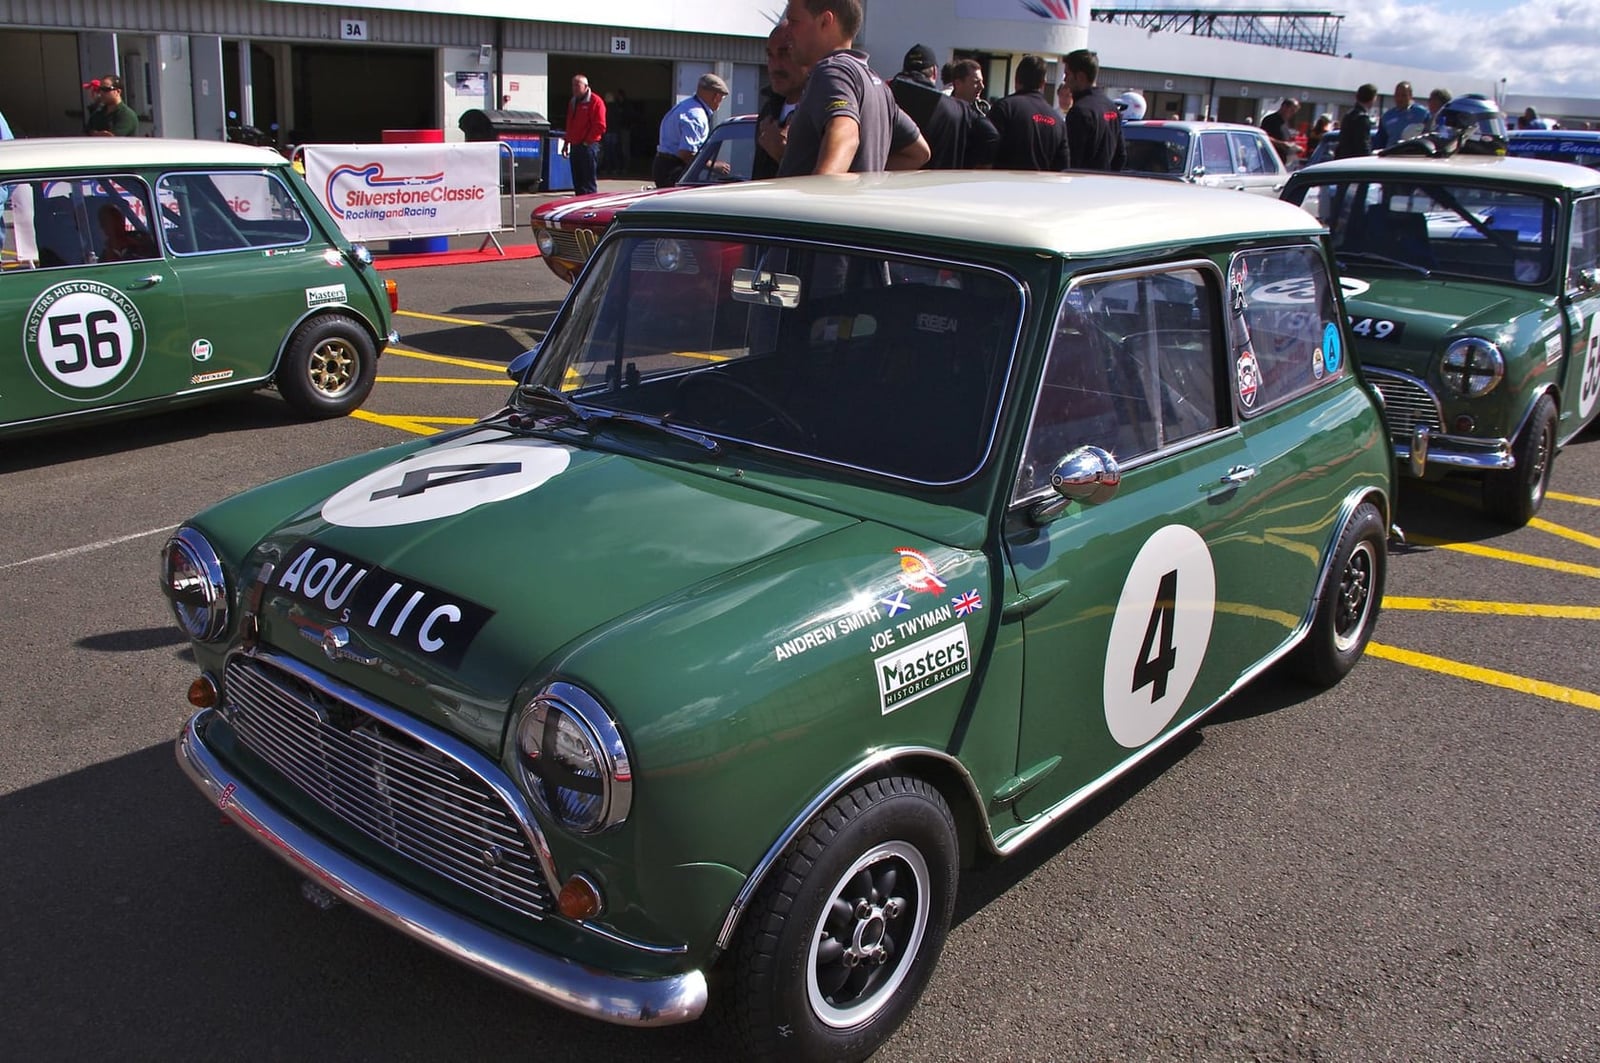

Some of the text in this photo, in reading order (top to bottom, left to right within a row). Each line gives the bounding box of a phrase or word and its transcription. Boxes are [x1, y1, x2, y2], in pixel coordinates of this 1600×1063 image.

[346, 23, 361, 36] 3A
[615, 40, 626, 50] 3B
[345, 207, 437, 220] RockingandRacing
[28, 283, 141, 343] MASTERS HISTORIC RACING
[308, 289, 345, 300] Masters
[48, 309, 122, 374] 56
[1348, 316, 1395, 339] 49
[370, 461, 522, 502] 4
[279, 547, 462, 653] AOU 11C
[774, 606, 882, 662] ANDREW SMITH
[869, 604, 952, 653] JOE TWYMAN
[1131, 568, 1178, 704] 4
[882, 640, 965, 692] Masters
[886, 662, 967, 705] HISTORIC RACING
